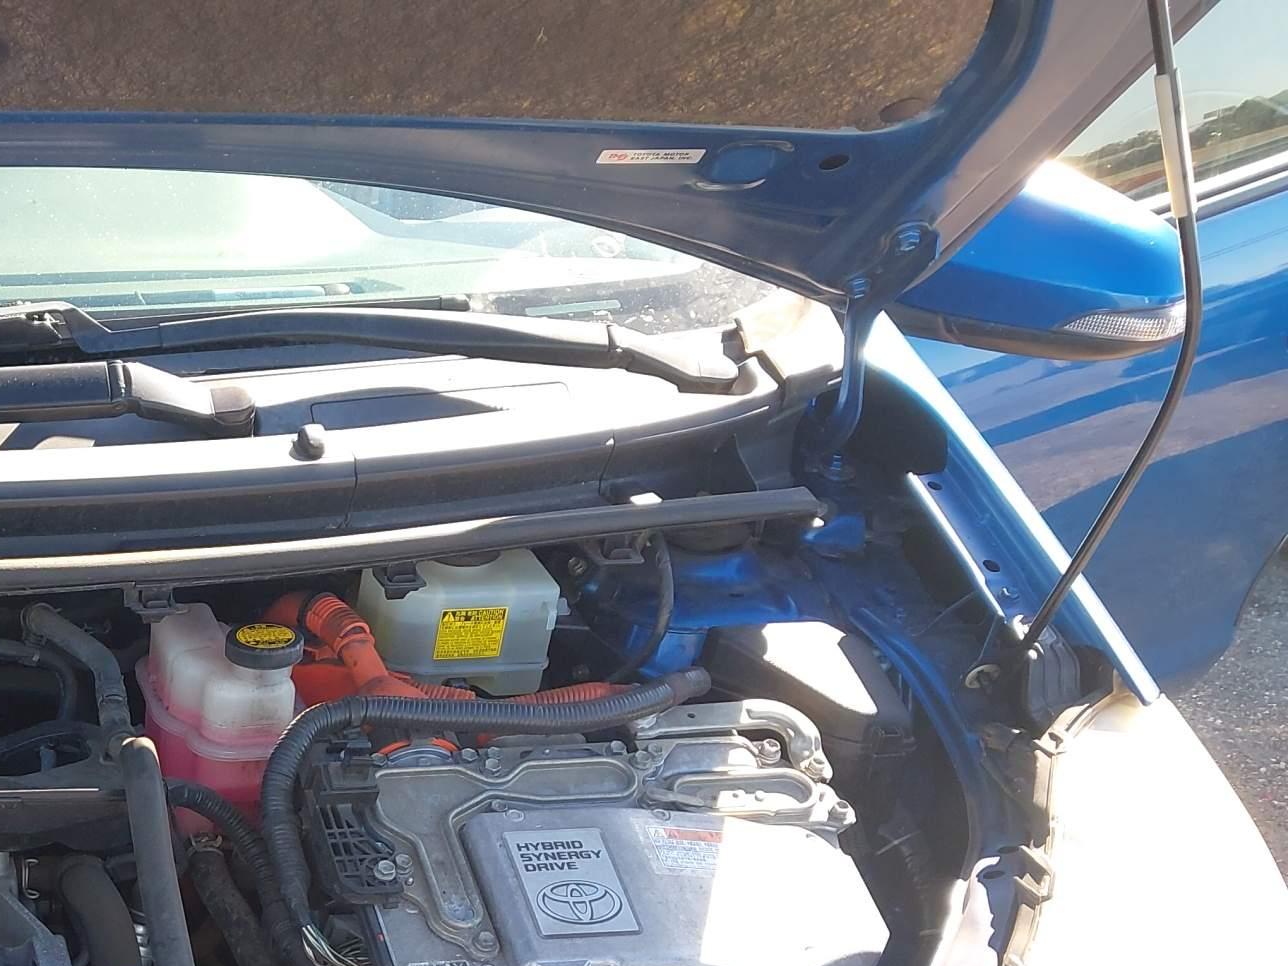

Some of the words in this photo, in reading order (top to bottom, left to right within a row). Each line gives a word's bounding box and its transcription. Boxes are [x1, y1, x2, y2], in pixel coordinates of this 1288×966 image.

[515, 840, 584, 851] HYBRID
[519, 849, 602, 862] SYNERGY
[523, 861, 580, 873] DRIVE
